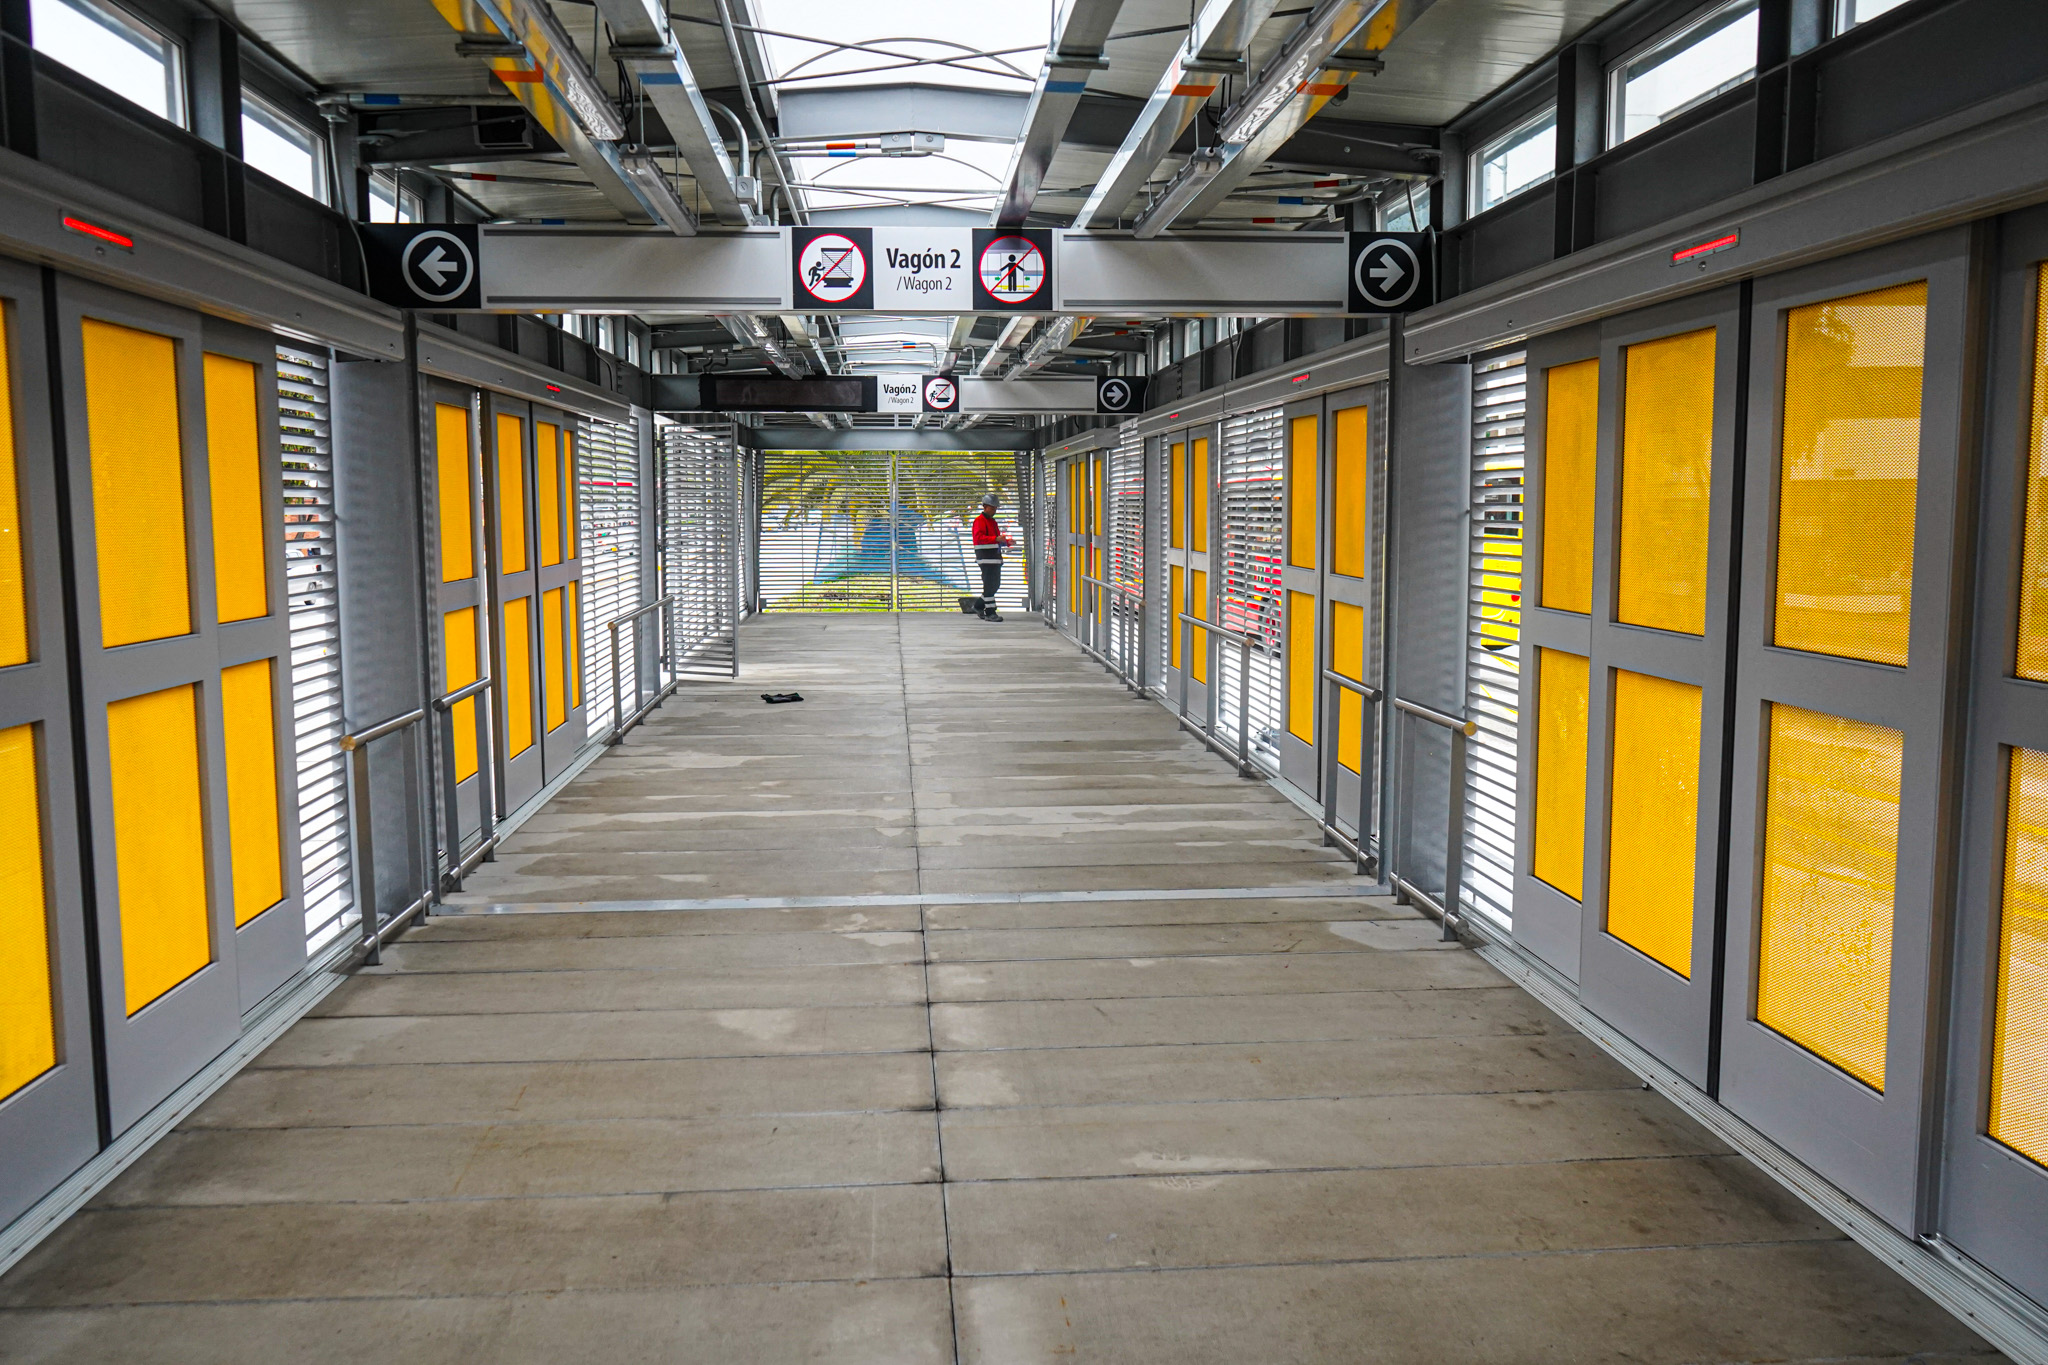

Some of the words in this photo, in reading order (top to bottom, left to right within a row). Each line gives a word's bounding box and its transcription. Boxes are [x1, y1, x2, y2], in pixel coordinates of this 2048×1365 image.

[886, 247, 946, 275] Vagón
[950, 248, 962, 270] 2
[945, 276, 952, 291] 2
